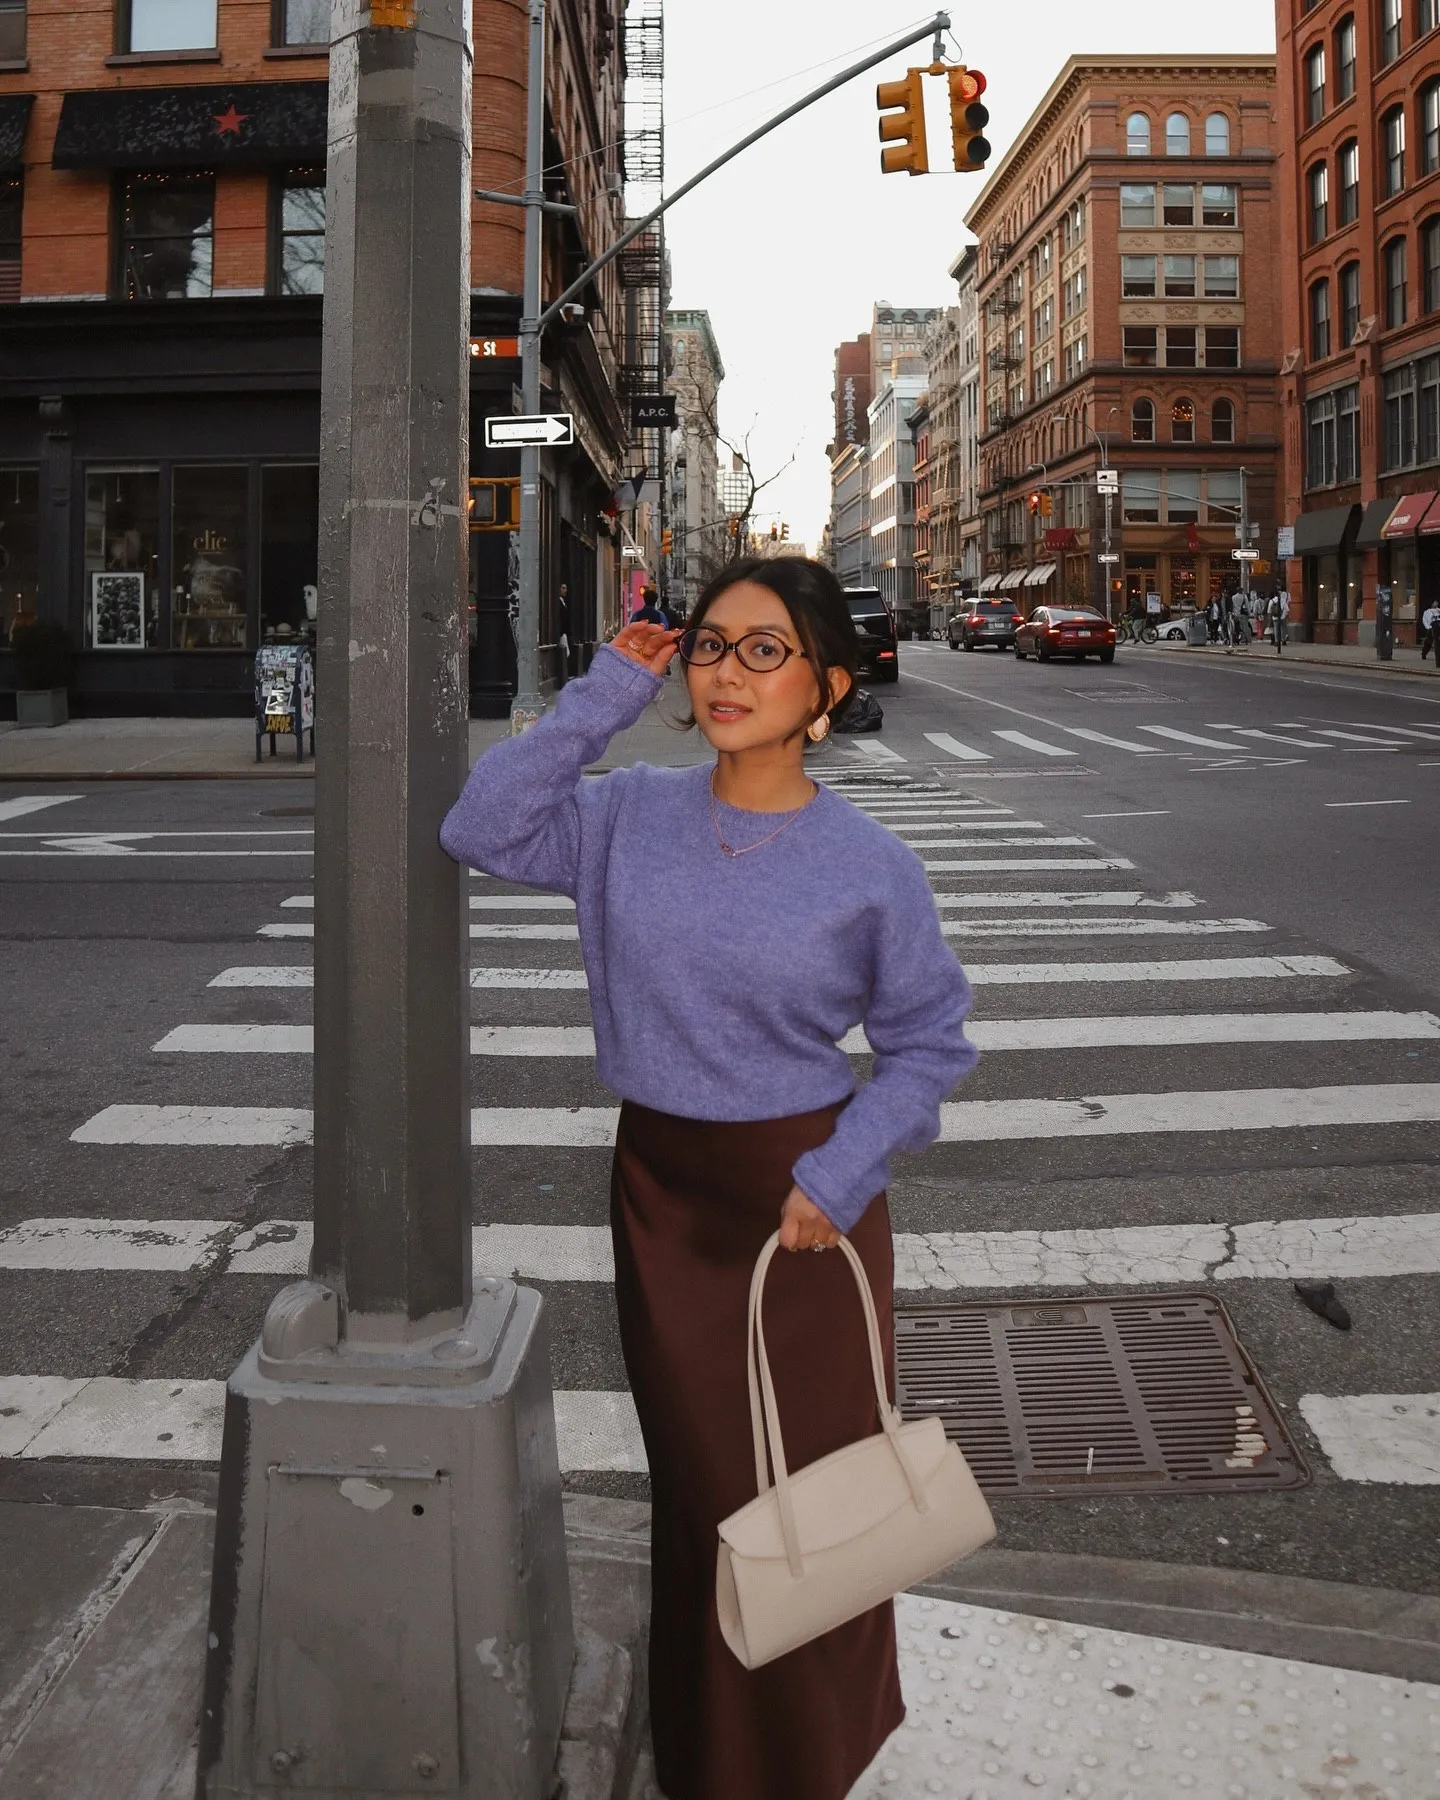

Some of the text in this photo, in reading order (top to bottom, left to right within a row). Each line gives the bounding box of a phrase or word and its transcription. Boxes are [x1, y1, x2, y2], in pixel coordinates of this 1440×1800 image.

[483, 341, 497, 356] St
[638, 407, 669, 417] A.P.C.
[192, 529, 228, 551] clic
